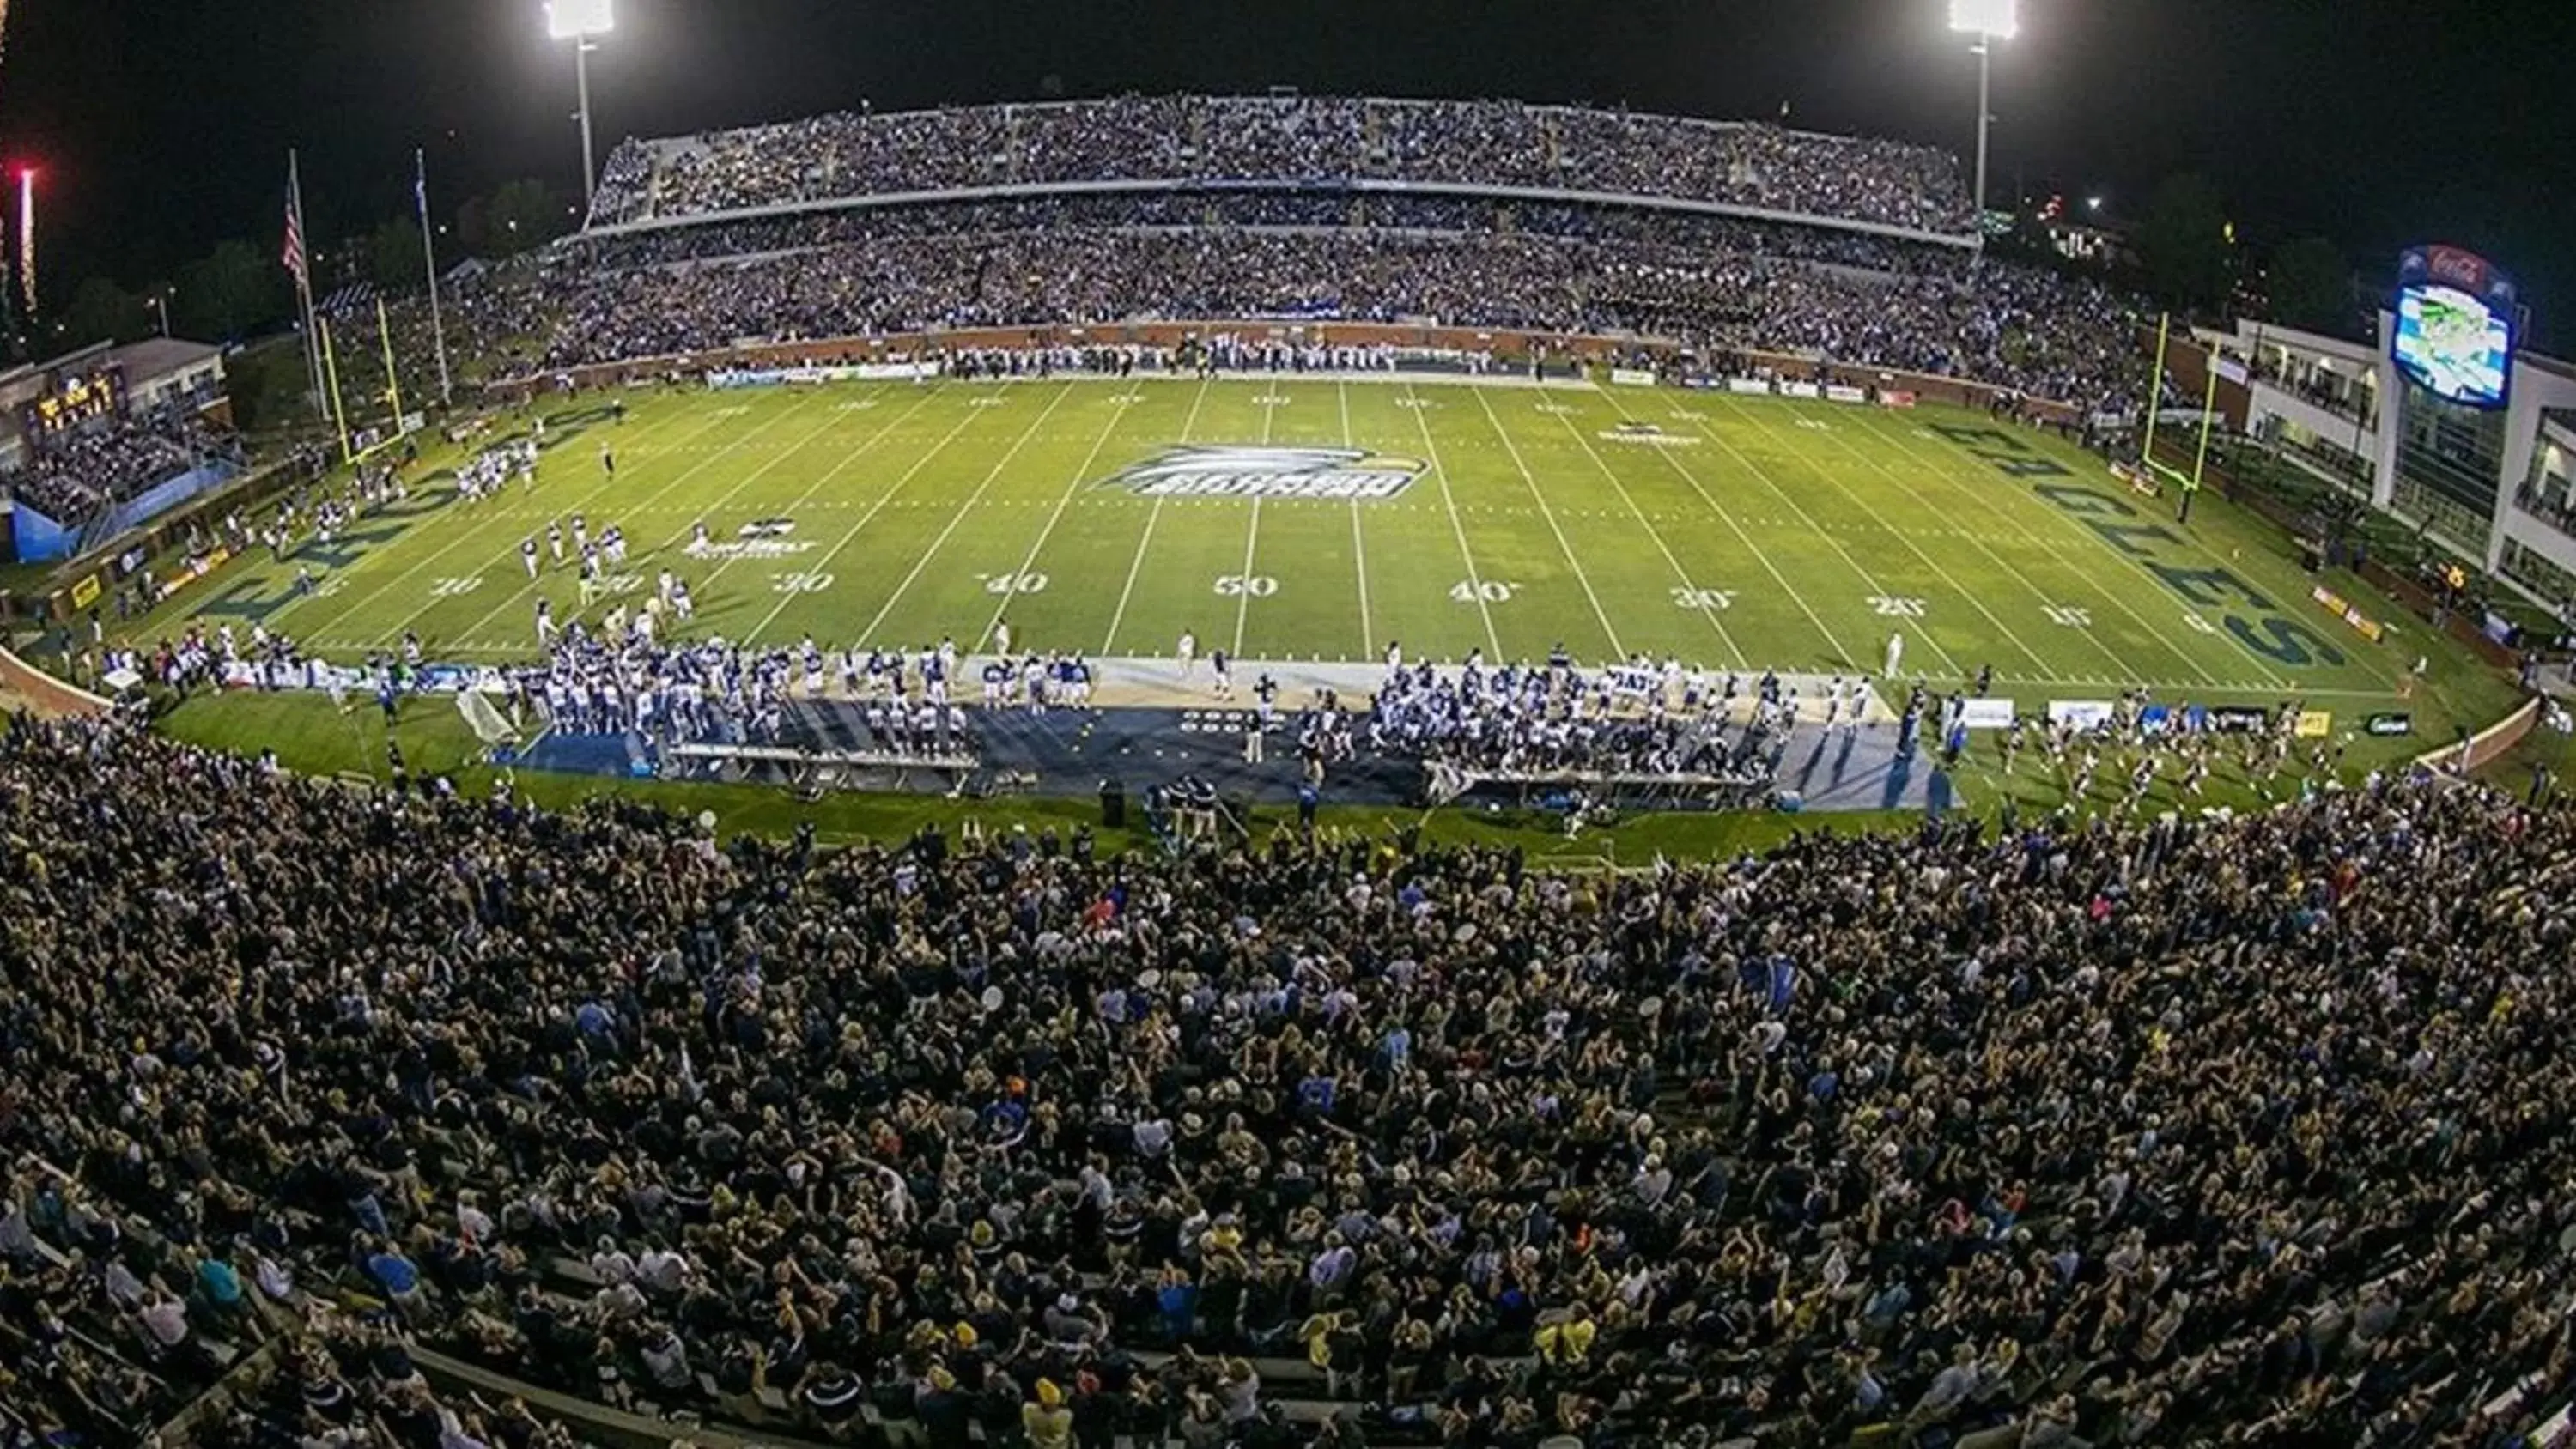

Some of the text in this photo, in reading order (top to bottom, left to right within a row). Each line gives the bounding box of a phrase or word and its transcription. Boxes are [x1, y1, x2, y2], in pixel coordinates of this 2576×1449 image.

[1924, 424, 2345, 667] EAGLES
[774, 573, 834, 591] 30
[985, 573, 1048, 594] 40
[1213, 575, 1278, 596] 50
[1449, 581, 1510, 602] 40
[1670, 589, 1728, 609] 30
